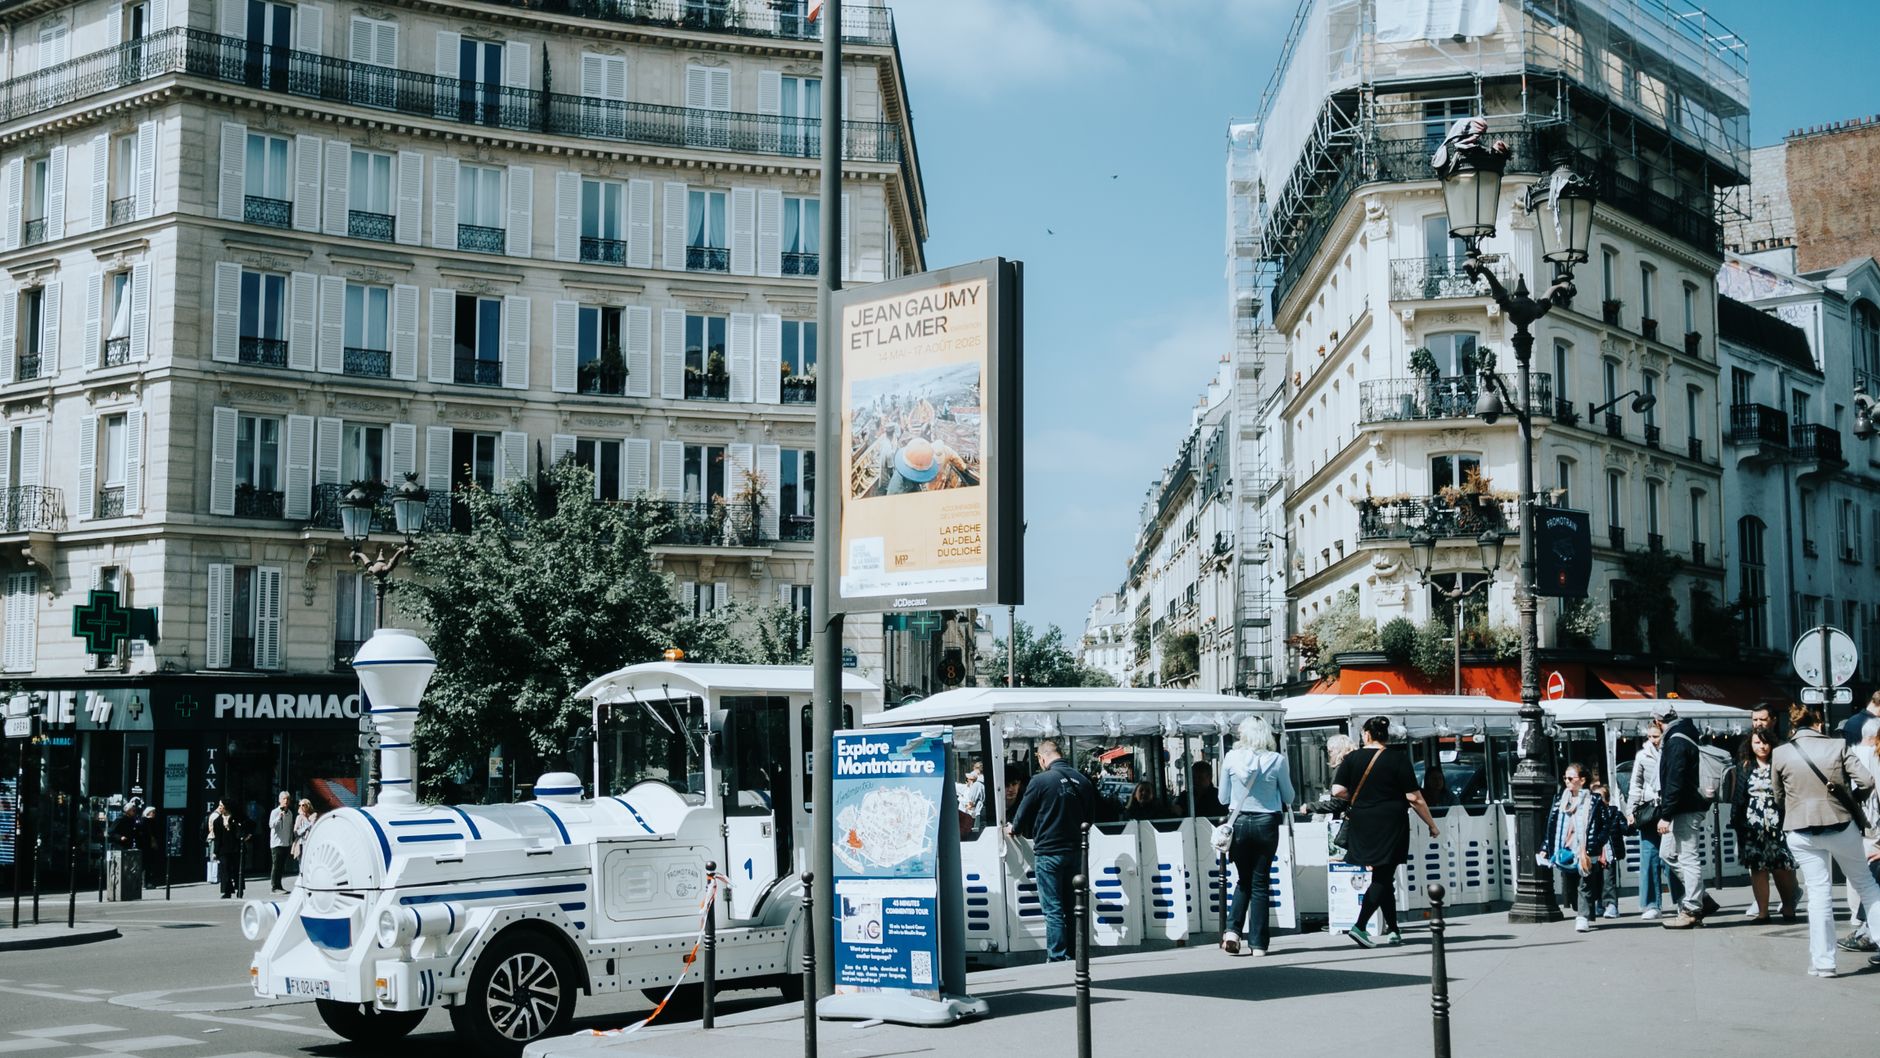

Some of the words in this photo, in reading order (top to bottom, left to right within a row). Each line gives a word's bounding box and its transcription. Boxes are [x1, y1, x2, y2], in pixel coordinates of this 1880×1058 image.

[851, 301, 901, 328] JEAN
[905, 285, 980, 317] GAUMY
[851, 330, 874, 350] ET
[877, 325, 902, 346] LA
[905, 315, 948, 340] MER
[955, 335, 981, 349] 2025
[939, 526, 951, 535] LA
[952, 523, 981, 534] PÊCHE
[942, 533, 981, 546] AU-DELÀ
[937, 548, 951, 557] DU
[951, 545, 982, 556] CLICHÉ
[893, 598, 928, 608] JCDecaux
[947, 665, 956, 679] 8
[214, 693, 360, 719] PHARMAC
[837, 737, 890, 760] Explore
[205, 748, 218, 790] TAX
[837, 756, 936, 775] Montmartre
[666, 868, 699, 880] PROMOTRAIN
[743, 857, 753, 881] 1
[885, 907, 915, 915] COMMENTED
[915, 908, 929, 916] TOUR
